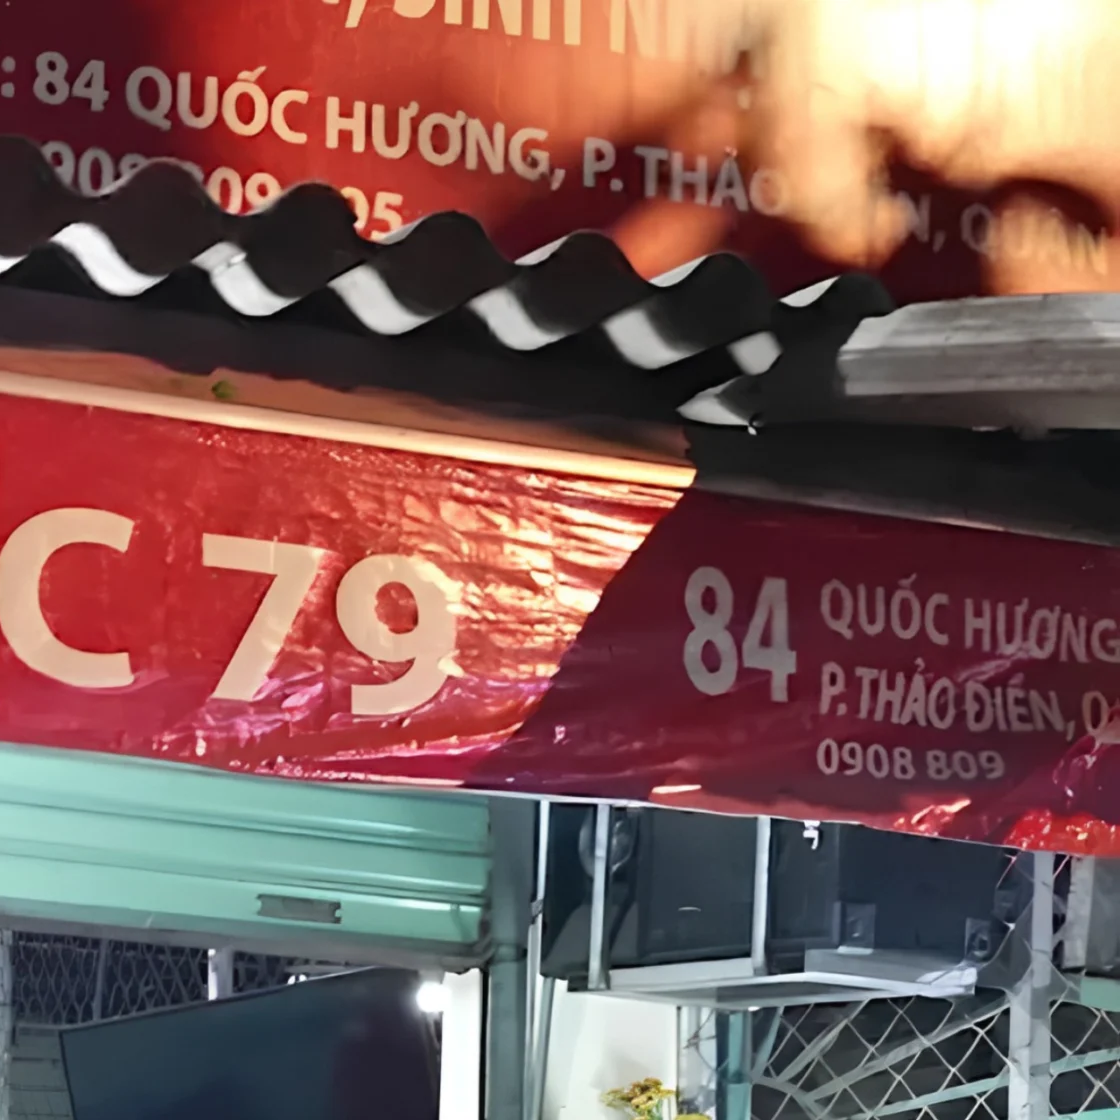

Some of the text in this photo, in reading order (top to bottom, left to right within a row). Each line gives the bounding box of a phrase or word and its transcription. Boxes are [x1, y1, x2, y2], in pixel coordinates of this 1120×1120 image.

[33, 51, 109, 111] 84
[125, 66, 308, 144] QUỐC
[325, 96, 566, 190] HƯƠNG,
[583, 137, 624, 192] P.
[202, 532, 458, 716] 79
[683, 566, 797, 703] 84
[820, 573, 950, 645] QUỐC
[816, 738, 1006, 781] 0908 809
